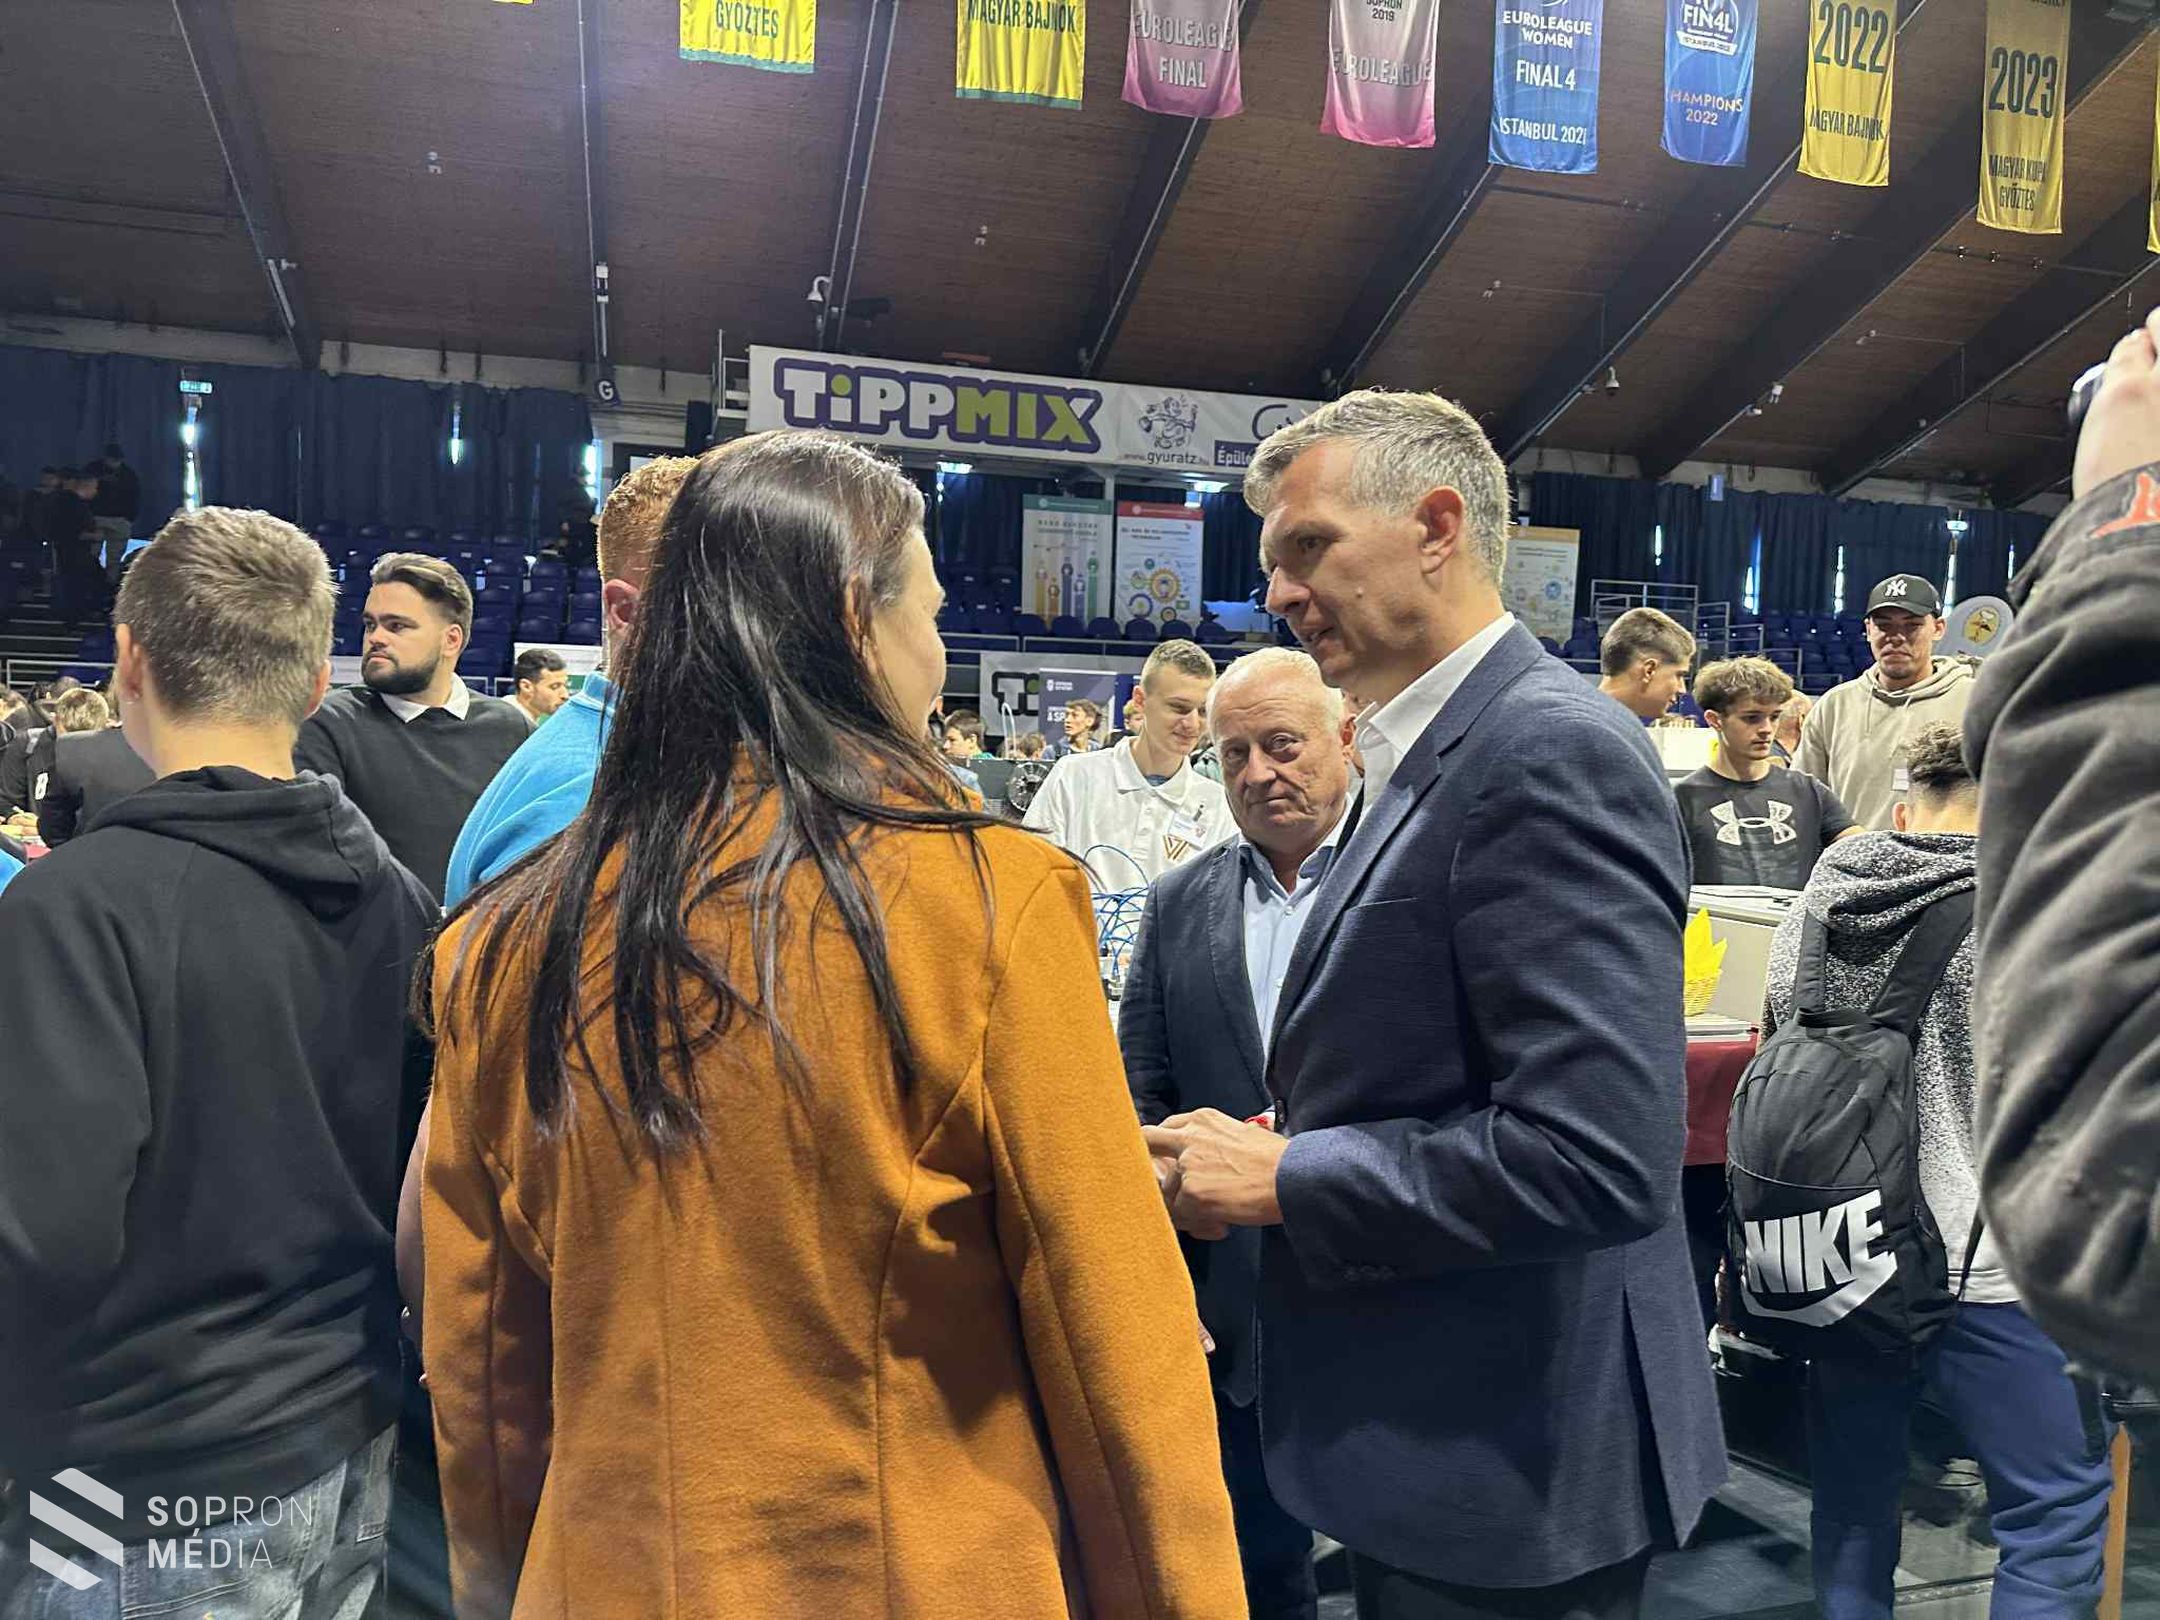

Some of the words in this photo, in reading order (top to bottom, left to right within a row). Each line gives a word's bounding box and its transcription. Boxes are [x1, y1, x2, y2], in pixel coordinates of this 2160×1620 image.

[1026, 0, 1076, 32] BAJNOK
[1372, 8, 1395, 21] 2019
[1503, 10, 1593, 35] EUROLEAGUE
[1522, 27, 1573, 48] WOMEN
[1813, 1, 1889, 73] 2022
[1158, 56, 1207, 89] FINAL
[1516, 60, 1563, 88] FINAL
[1565, 68, 1576, 91] 4
[1988, 47, 2058, 118] 2023
[1670, 89, 1744, 112] HAMPIONS
[1686, 108, 1718, 125] 2022
[599, 381, 614, 400] G
[1744, 1189, 1884, 1294] NIKE
